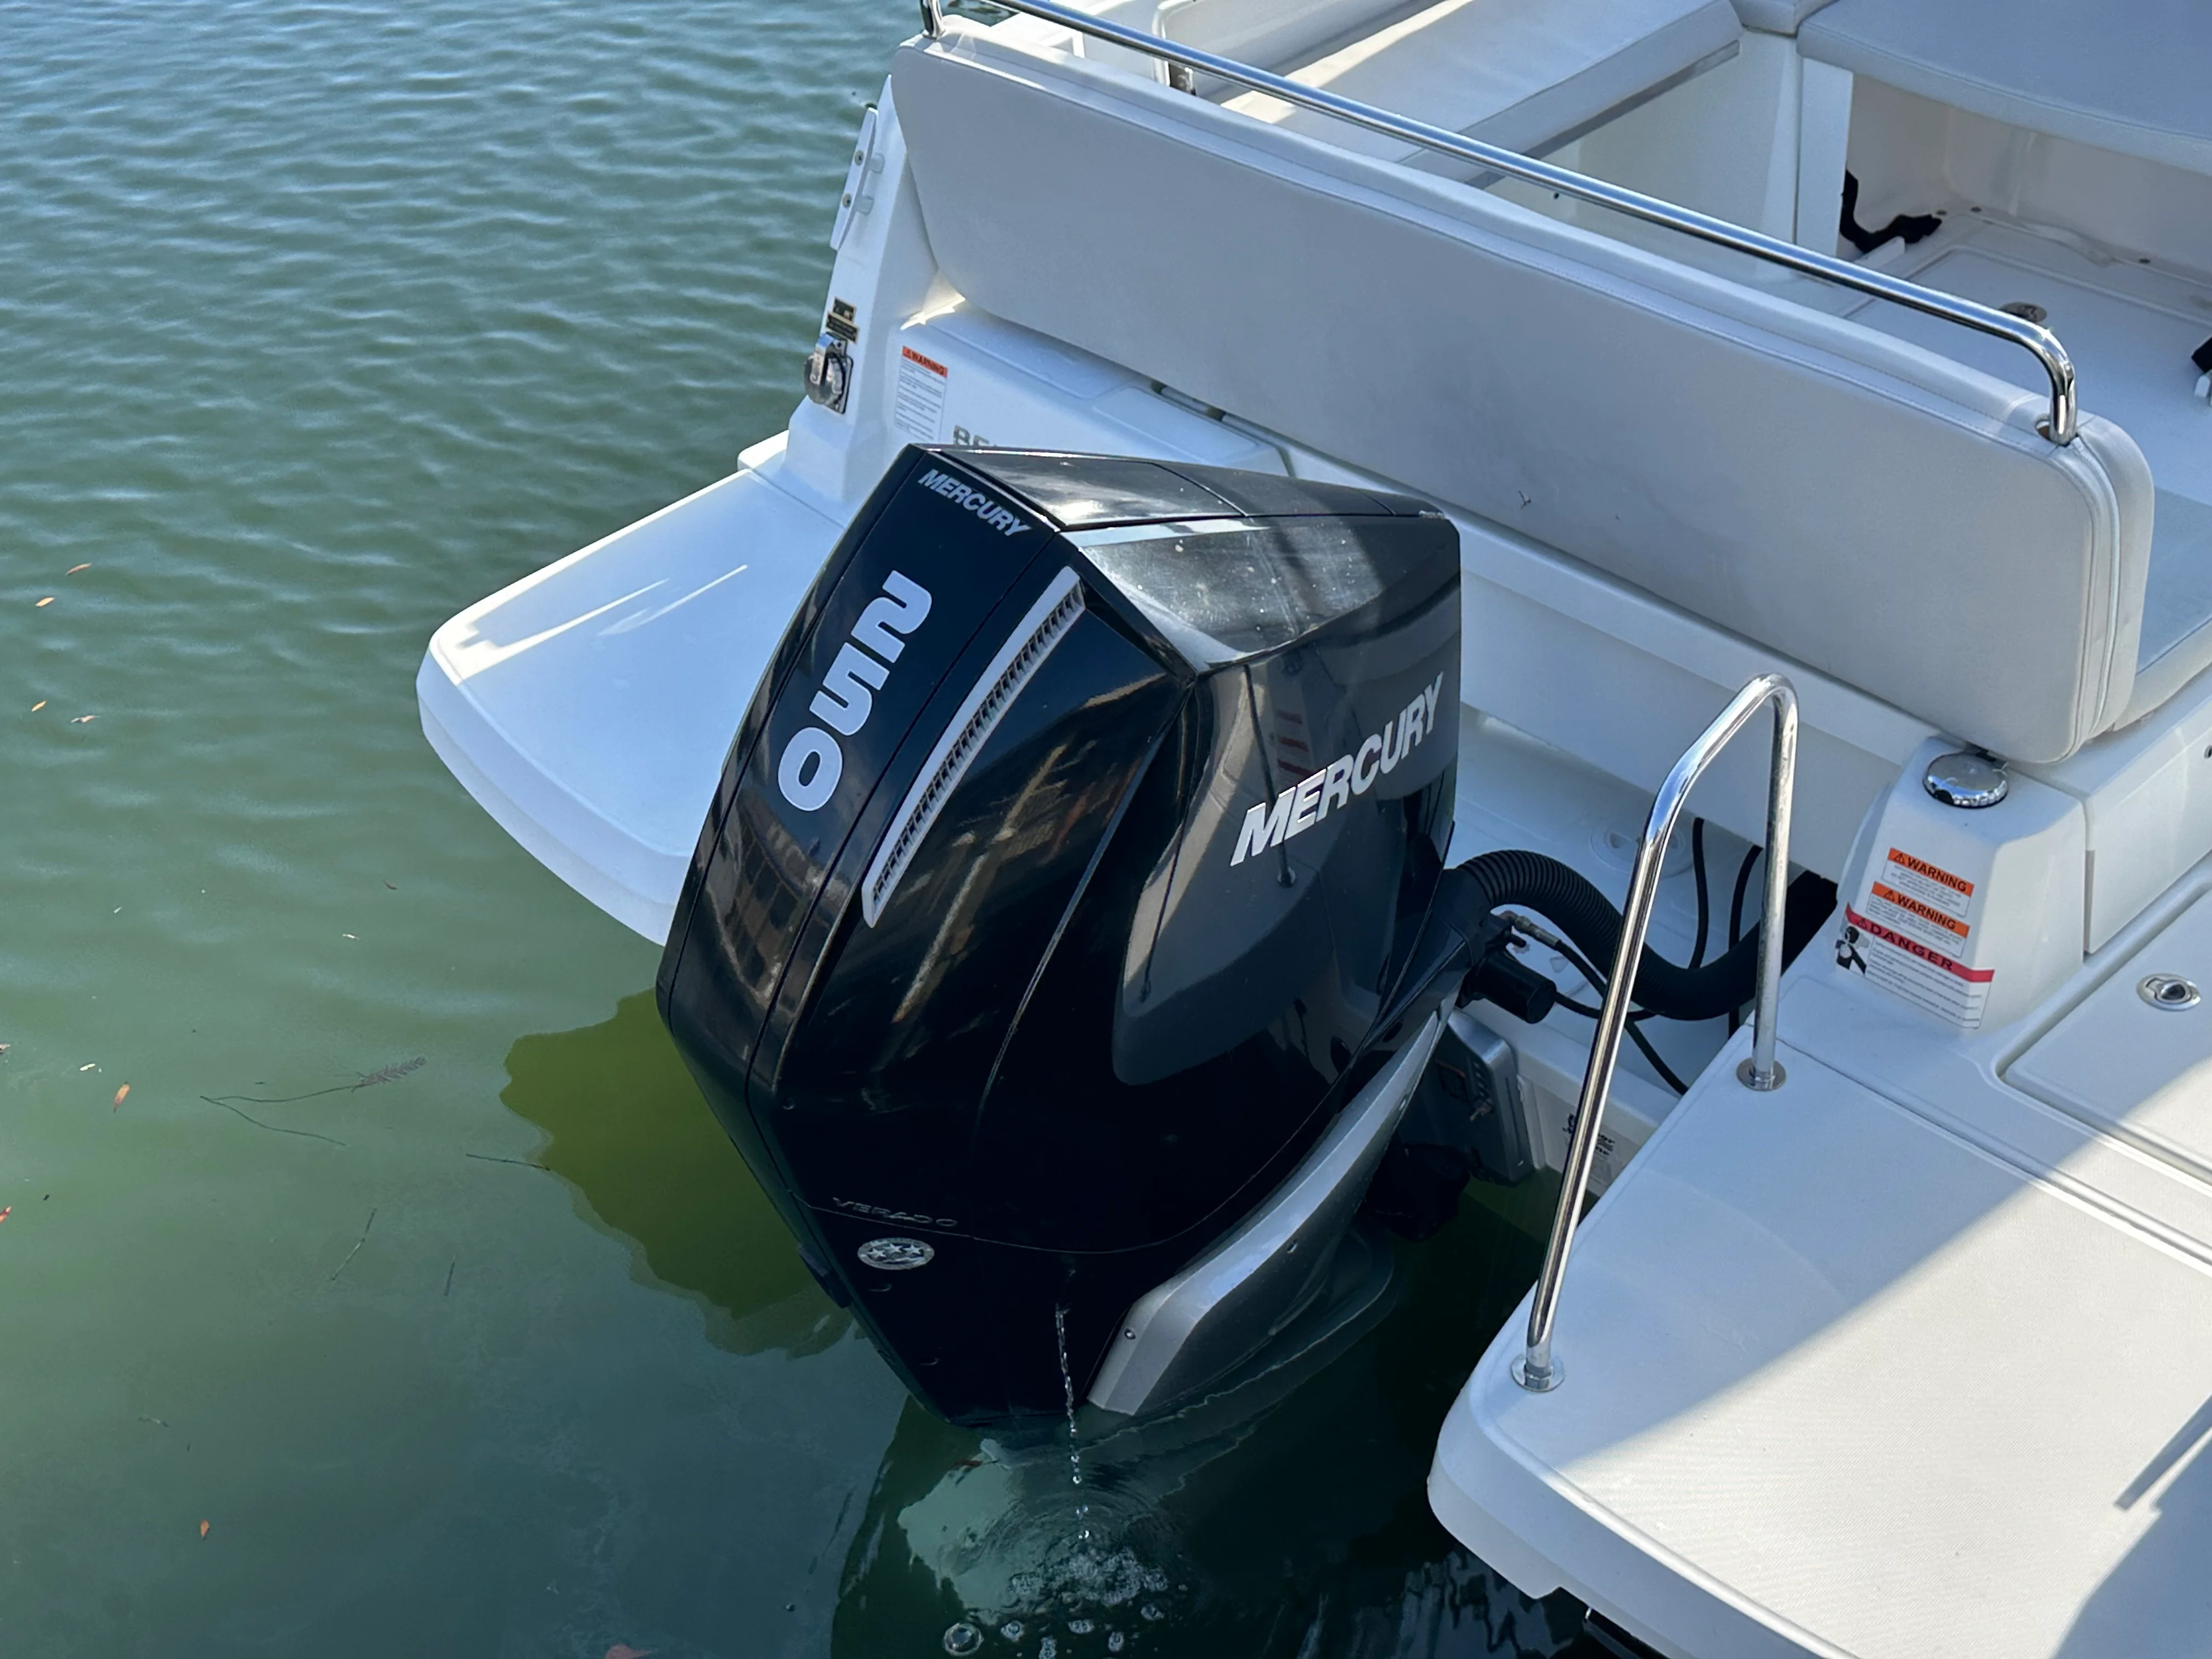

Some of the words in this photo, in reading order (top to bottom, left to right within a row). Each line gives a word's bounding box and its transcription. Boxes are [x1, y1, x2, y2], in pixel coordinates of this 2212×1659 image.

[917, 469, 1032, 537] MERCURY
[778, 569, 933, 811] 250
[1230, 672, 1443, 867] MERCURY
[1907, 856, 1967, 892] WARNING
[1897, 894, 1956, 930] WARNING
[1869, 922, 1953, 971] DANGER
